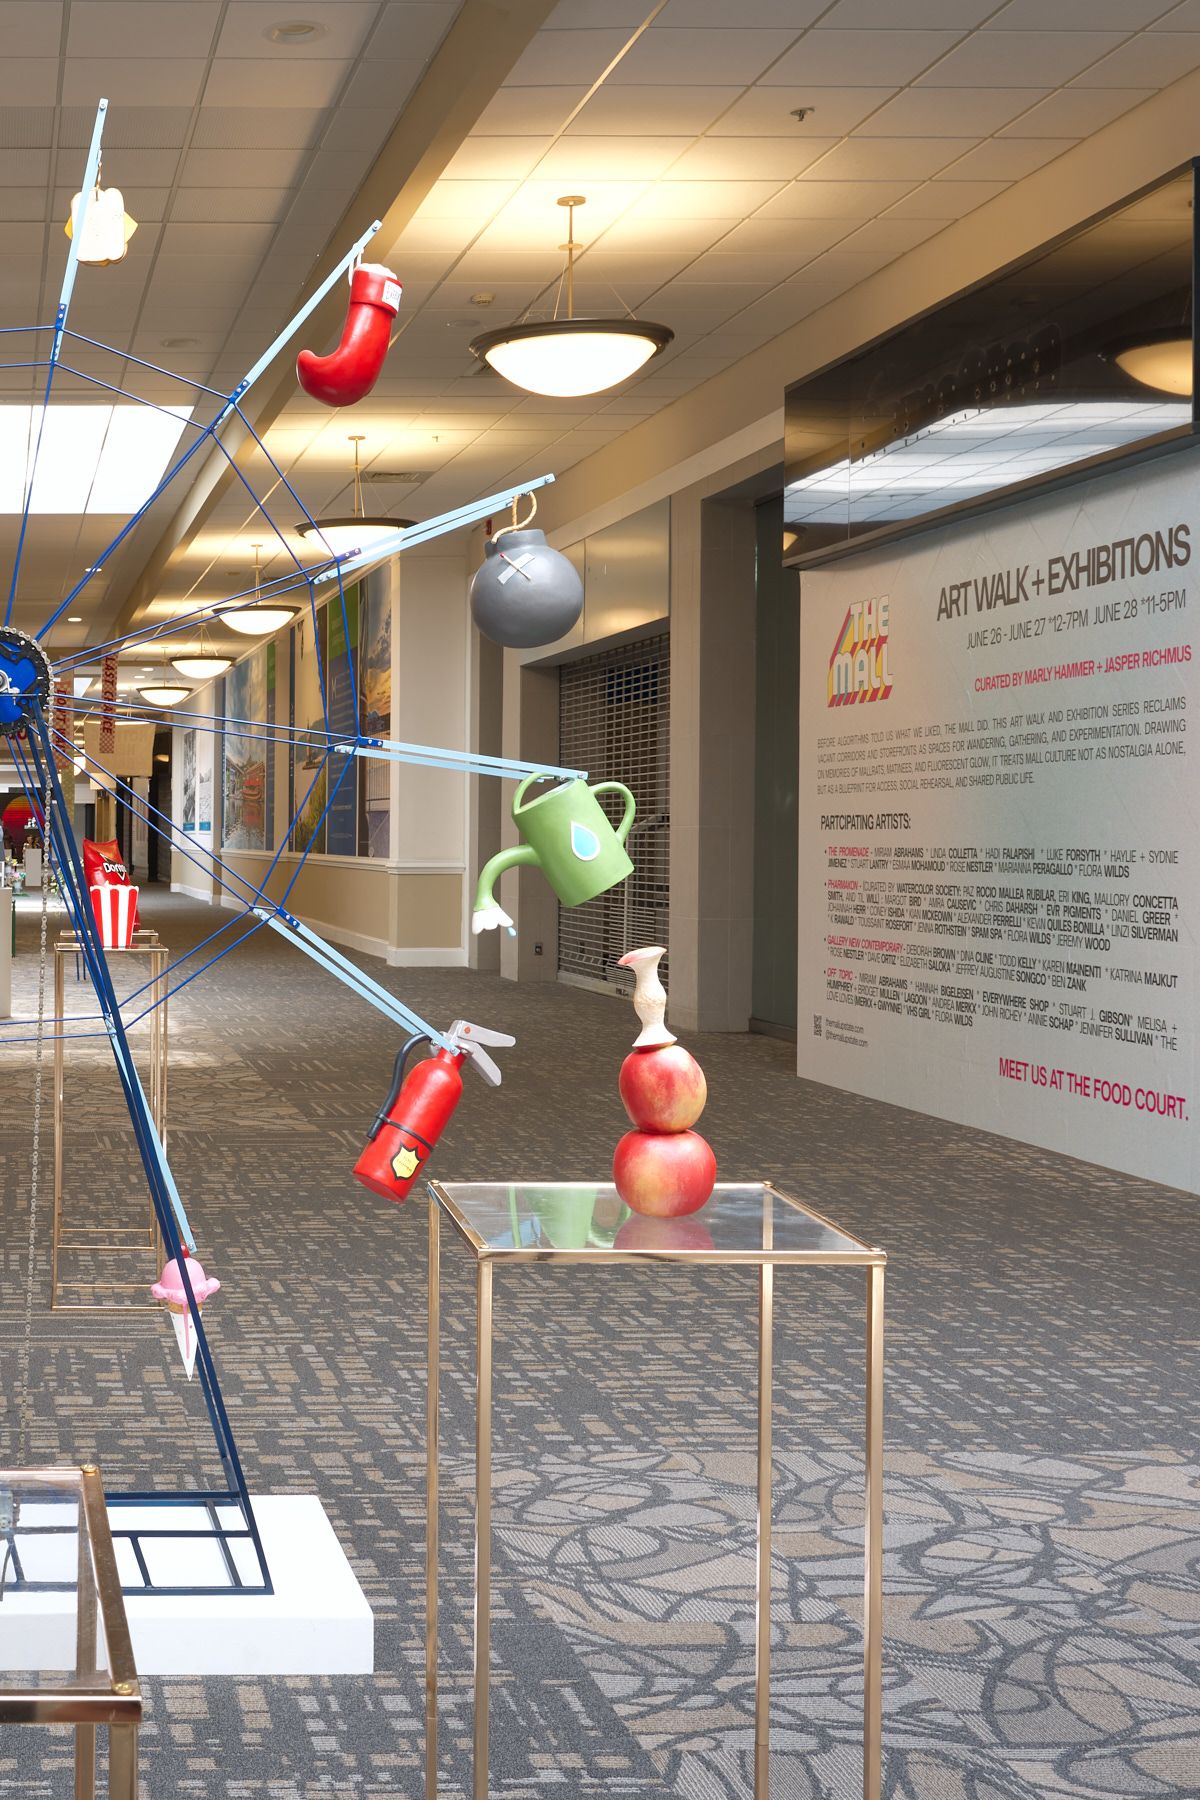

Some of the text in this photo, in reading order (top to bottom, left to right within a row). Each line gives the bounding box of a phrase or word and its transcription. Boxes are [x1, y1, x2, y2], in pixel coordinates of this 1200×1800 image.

[937, 580, 972, 622] ART
[974, 565, 1030, 613] WALK
[1048, 522, 1191, 597] EXHIBITIONS
[850, 594, 889, 643] THE
[967, 629, 988, 650] JUNE
[990, 626, 1002, 646] 26
[1009, 620, 1031, 642] JUNE
[1034, 617, 1046, 637] 27
[1094, 602, 1121, 626] JUNE
[1124, 598, 1138, 620] 28
[104, 657, 116, 687] LAST
[831, 643, 893, 698] MALL
[975, 673, 1010, 693] CURATED
[1012, 671, 1023, 687] BY
[1025, 666, 1052, 685] MARLY
[1054, 659, 1094, 681] HAMMER
[1104, 652, 1140, 673] JASPER
[1142, 644, 1192, 668] RICHMUS
[945, 723, 956, 735] THE
[959, 720, 974, 734] MALL
[977, 719, 990, 732] DID.
[993, 717, 1007, 730] THIS
[1010, 715, 1023, 728] ART
[1026, 713, 1044, 726] WALK
[1049, 710, 1064, 724] AND
[1067, 705, 1108, 722] EXHIBITION
[1112, 702, 1140, 717] SERIES
[1144, 696, 1186, 714] RECLAIMS
[929, 718, 1186, 754] SPACES FOR WANDERING, GATHERING, AND EXPERIMENTATION. DRAWING
[928, 741, 1186, 772] FLUORESCENT GLOW, IT TREATS MALL CULTURE NOT AS NOSTALGIA ALONE,
[970, 774, 994, 787] SHARED
[996, 773, 1018, 786] PUBLIC
[1020, 772, 1035, 785] LIFE.
[876, 813, 911, 829] ARTISTS:
[894, 847, 924, 858] ABRAHAMS
[948, 848, 978, 860] COLLETTA
[1047, 849, 1063, 861] LUKE
[1066, 849, 1100, 862] FORSYTH
[1111, 850, 1136, 863] HAYLIE
[1149, 850, 1179, 864] SYDNIE
[911, 861, 1130, 878] MOHAMOUD NESTLER PERAGALLO FLORA WILDS
[897, 883, 934, 896] WATERCOLOR
[936, 885, 962, 898] SOCIETY:
[976, 887, 996, 900] ROCIO
[999, 888, 1024, 901] MALLEA
[1027, 889, 1056, 903] RUBILAR,
[1072, 891, 1092, 905] KING,
[1094, 892, 1130, 907] MALLORY
[1133, 894, 1179, 910] CONCETTA
[946, 899, 1171, 925] CAUSEVIC CHRIS DAHARSH EVR PIGMENTS DANIEL GREER
[922, 910, 1178, 942] MCKEOWN PERRELLI QUILES BONILLA SILVERMAN
[935, 923, 1110, 951] ROTHSTEIN SPAM SPA FLORA WILDS WOOD
[933, 947, 956, 961] BROWN
[975, 952, 994, 965] CLINE
[999, 955, 1017, 968] TODD
[1018, 957, 1037, 971] KELLY
[1042, 960, 1066, 974] KAREN
[1066, 963, 1102, 979] MAINENTI
[1110, 967, 1142, 984] KATRINA
[1144, 971, 1178, 988] MAJKUT
[1016, 970, 1087, 992] SONGCO BEN ZANK
[954, 1013, 973, 1027] WILDS
[982, 991, 1027, 1010] EVERYWHERE
[1030, 999, 1050, 1013] SHOP
[1059, 1003, 1087, 1019] STUART
[1138, 1015, 1167, 1032] MELISA
[1080, 1021, 1178, 1051] JENNIFER SULLIVAN THE
[1000, 1057, 1189, 1120] MEET US AT THE FOOD COURT.
